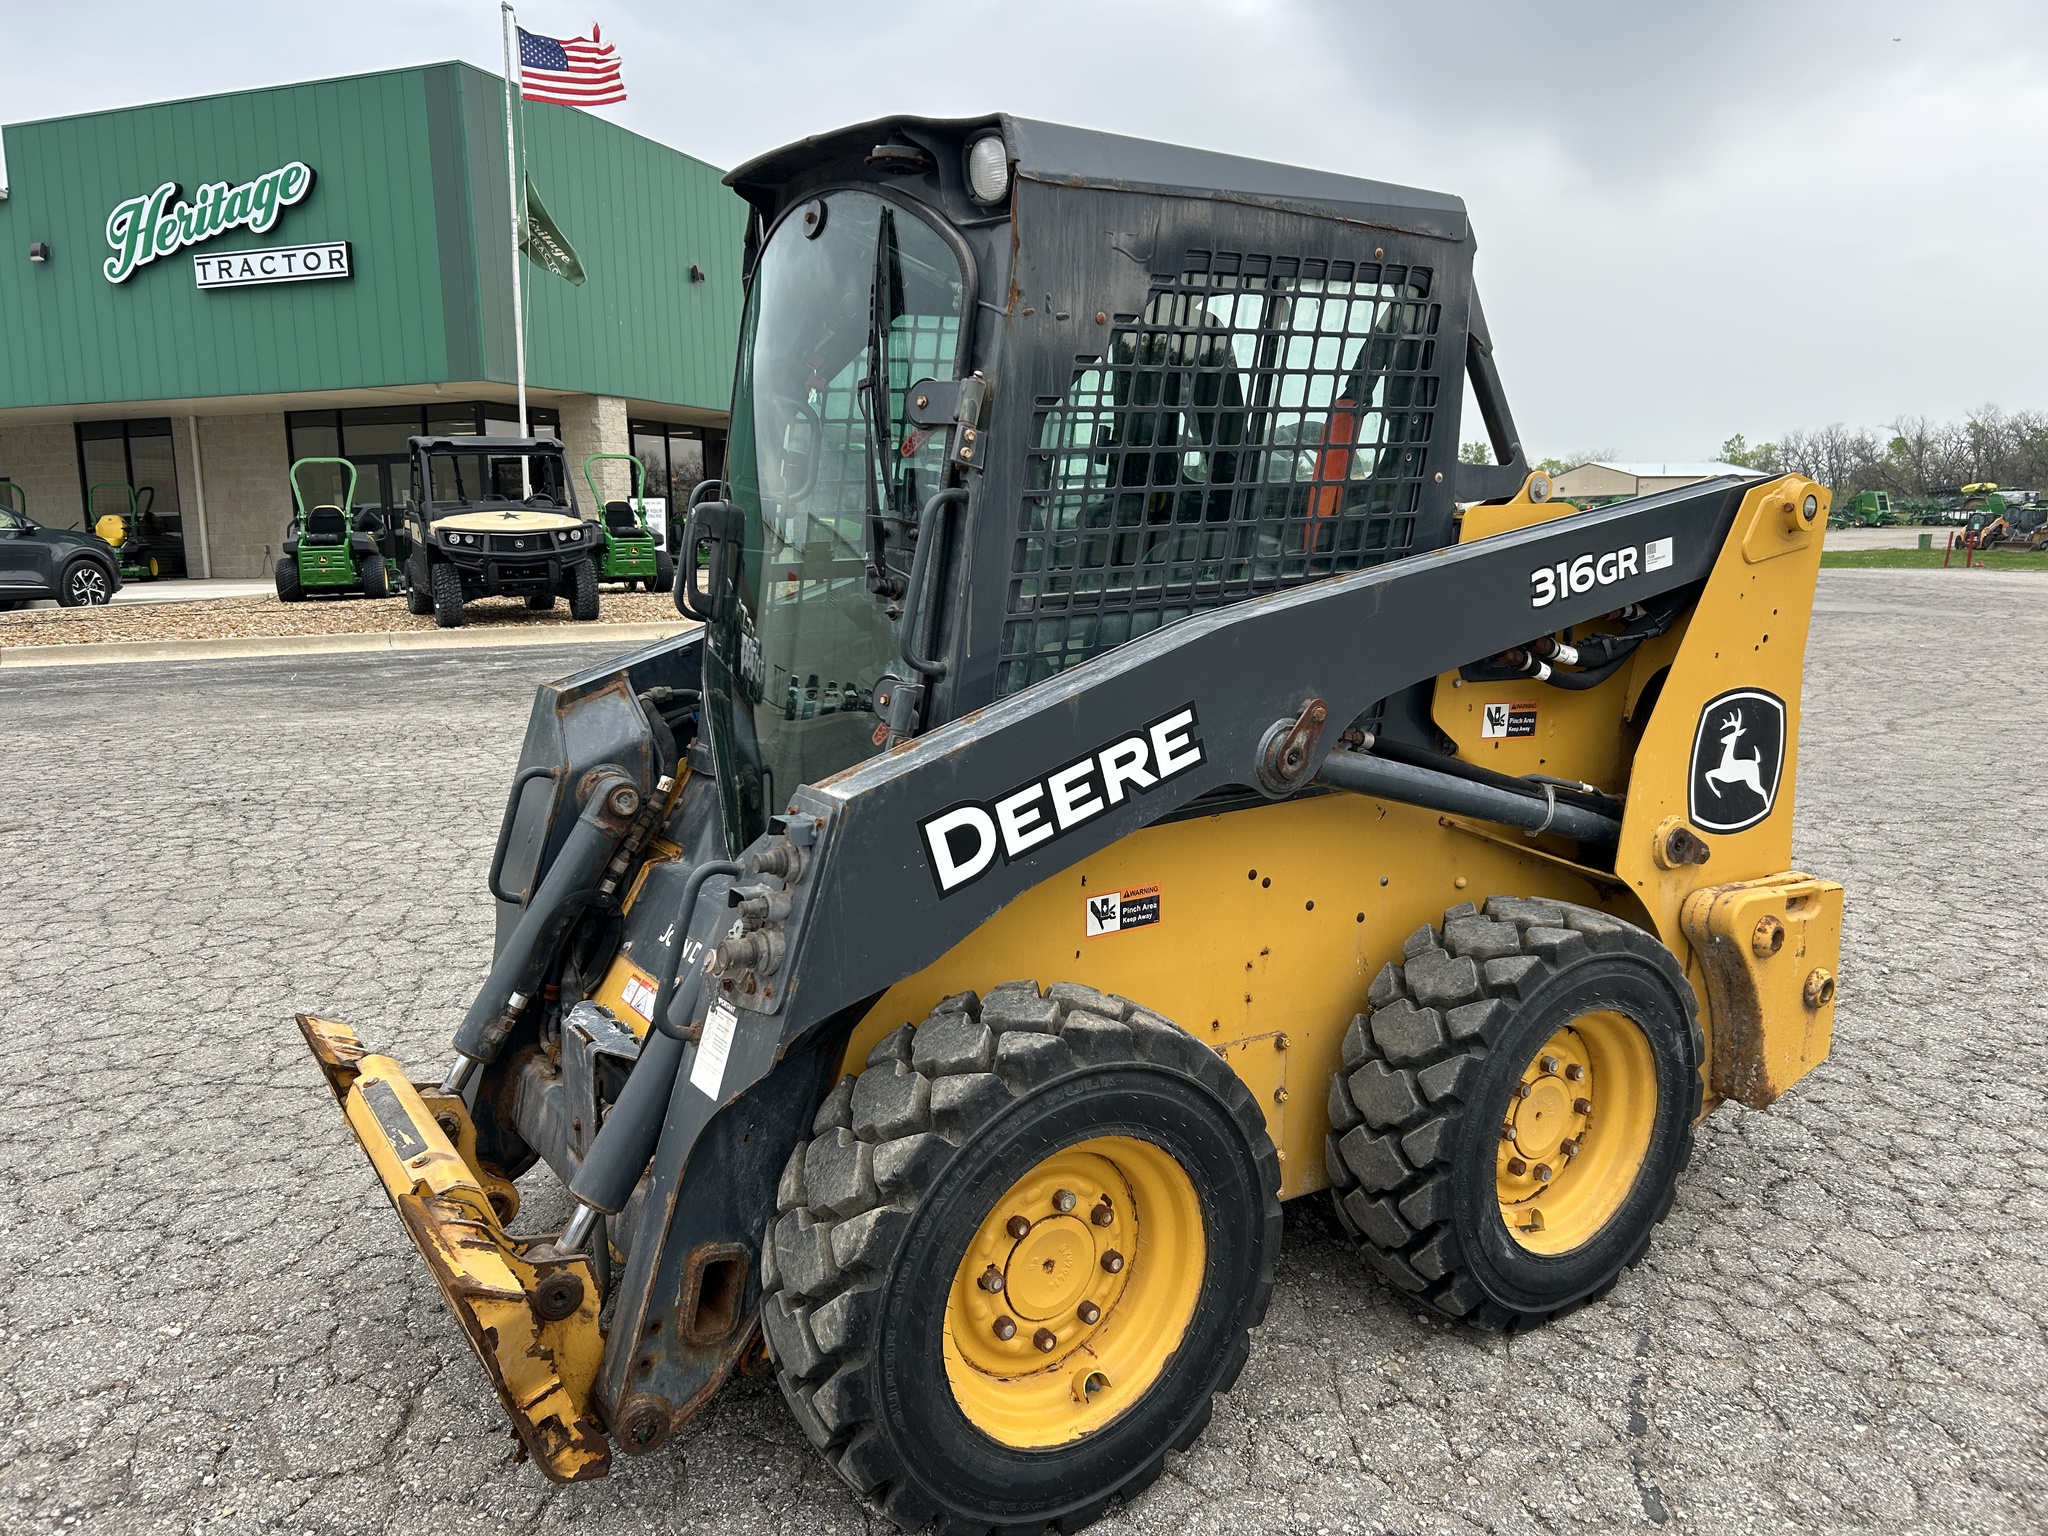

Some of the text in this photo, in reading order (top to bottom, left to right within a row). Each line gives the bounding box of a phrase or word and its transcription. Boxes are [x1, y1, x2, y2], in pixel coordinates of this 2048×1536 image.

[104, 161, 311, 283] Heritage
[196, 249, 346, 281] TRACTOR
[531, 232, 559, 275] RACTO
[1531, 546, 1639, 607] 316GR
[925, 709, 1201, 891] DEERE
[1122, 902, 1157, 915] Pinch Area
[1129, 886, 1159, 897] WARNING
[1122, 912, 1153, 924] Keep Away
